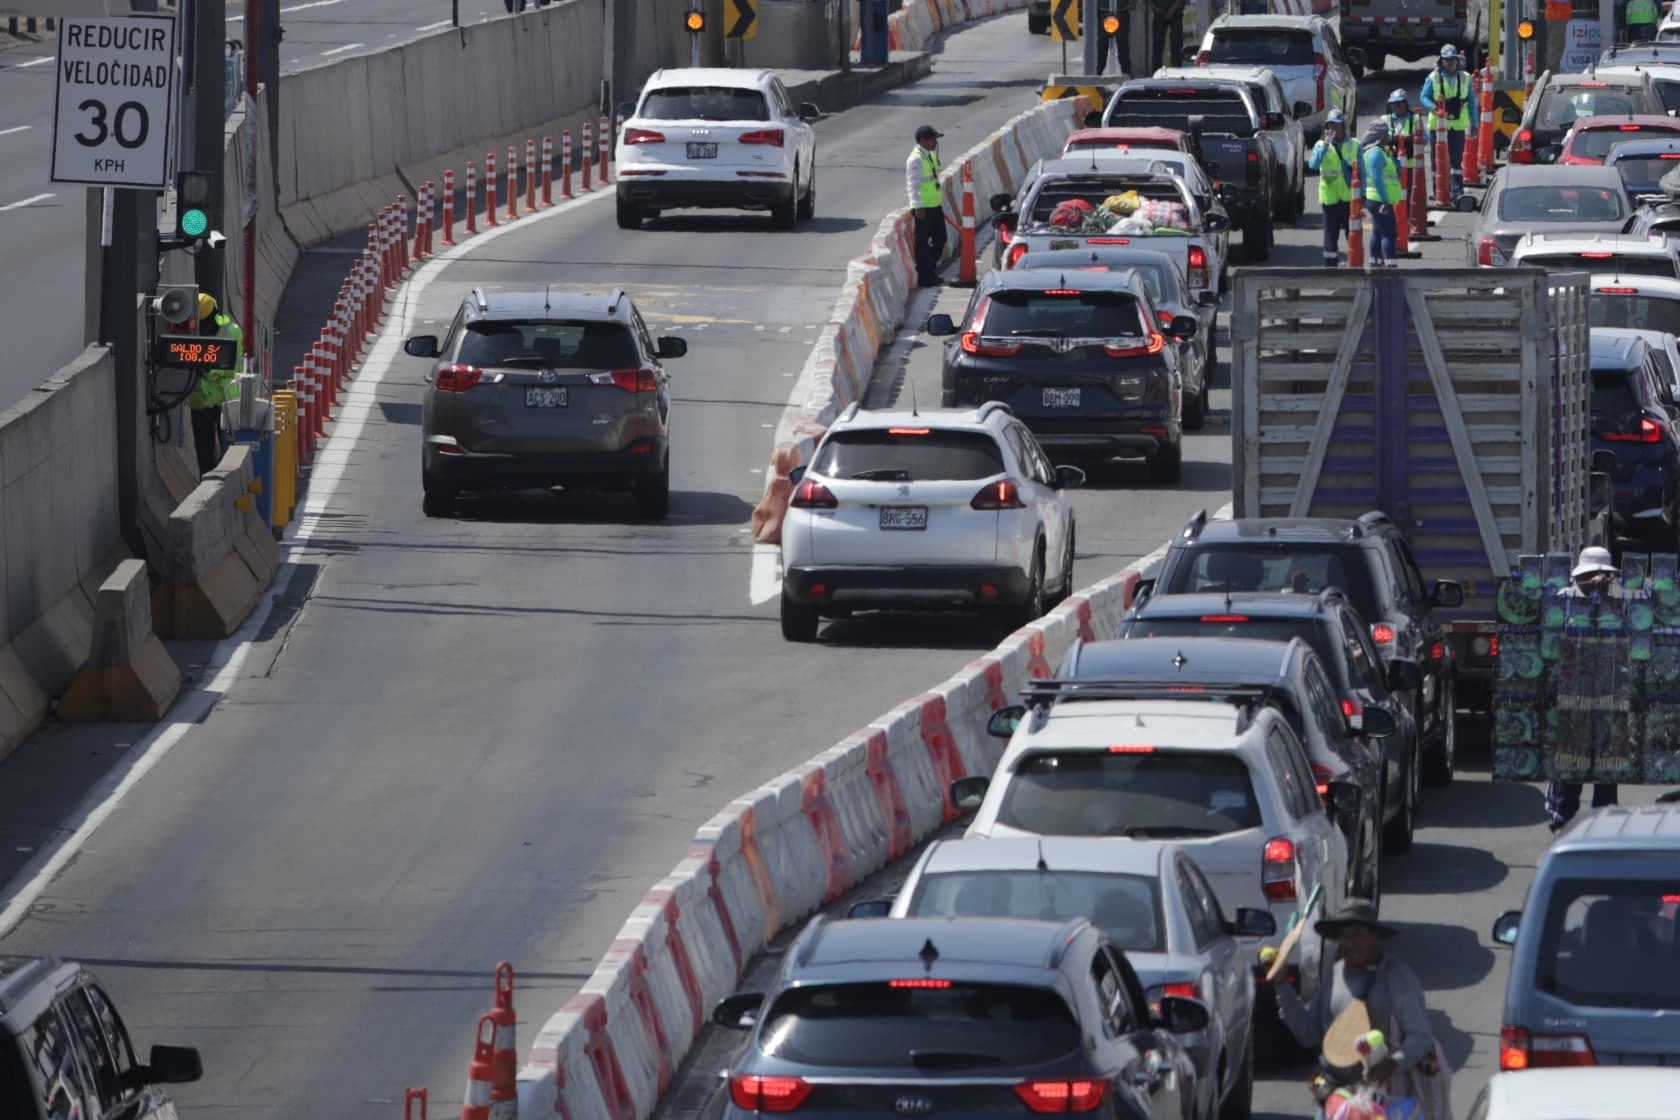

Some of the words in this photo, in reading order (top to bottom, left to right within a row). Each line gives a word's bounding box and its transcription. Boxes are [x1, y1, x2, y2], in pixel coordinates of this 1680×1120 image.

[67, 23, 166, 52] REDUCIR
[63, 59, 167, 88] VELOCIDAD
[73, 98, 150, 149] 30
[94, 158, 125, 172] KPH
[170, 343, 202, 353] SALDO
[207, 344, 221, 354] S/
[180, 352, 217, 363] 108.00
